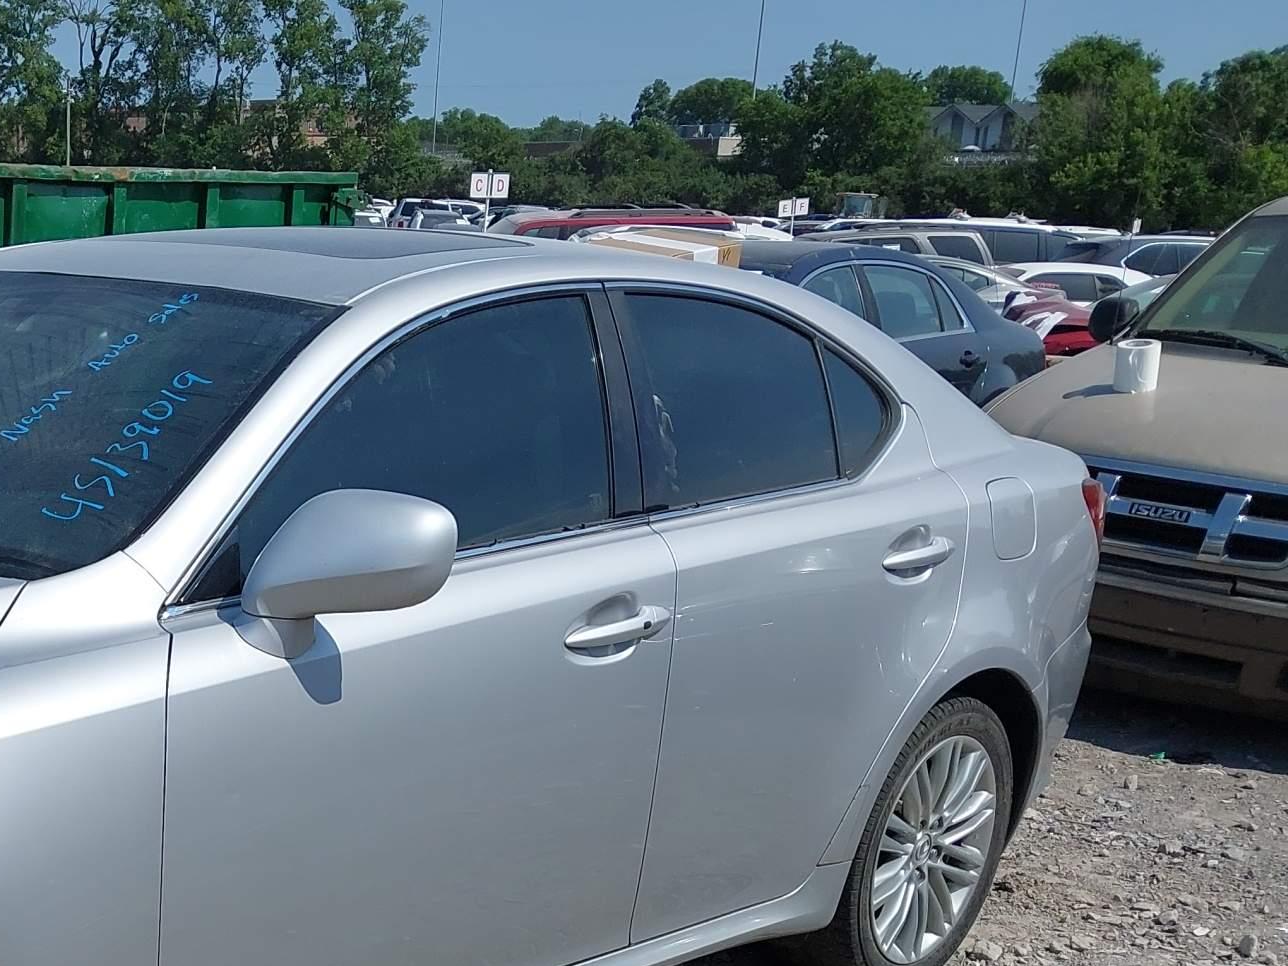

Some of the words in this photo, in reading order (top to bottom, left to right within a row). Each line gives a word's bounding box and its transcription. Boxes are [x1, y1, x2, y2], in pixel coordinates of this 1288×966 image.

[475, 178, 483, 192] C
[497, 179, 505, 192] D
[0, 388, 73, 441] Nash
[41, 369, 213, 521] 45139019
[1131, 503, 1188, 522] ISUZU
